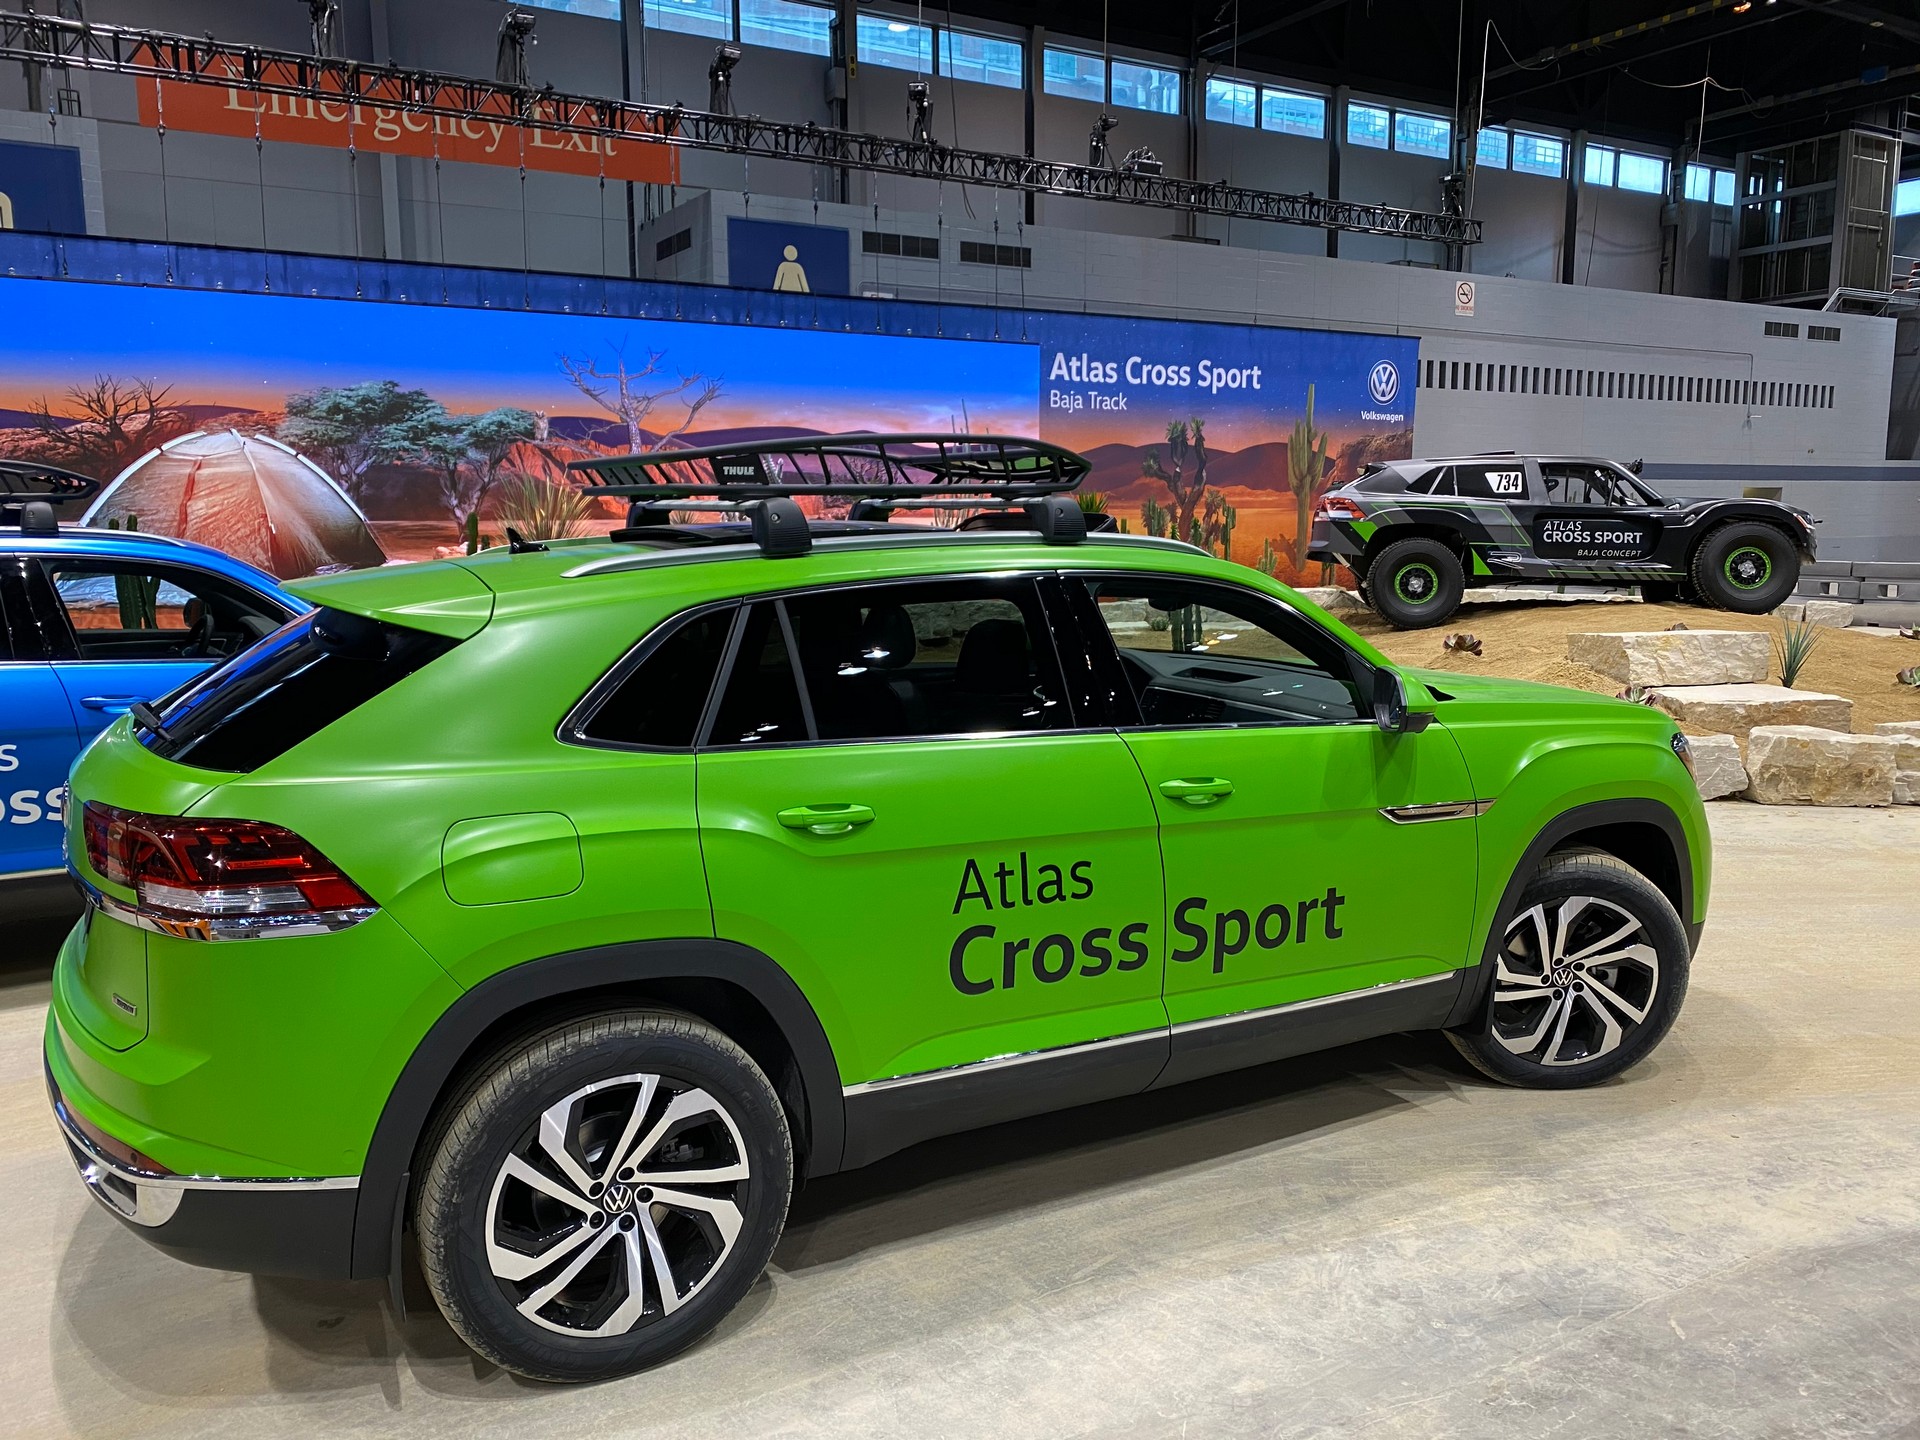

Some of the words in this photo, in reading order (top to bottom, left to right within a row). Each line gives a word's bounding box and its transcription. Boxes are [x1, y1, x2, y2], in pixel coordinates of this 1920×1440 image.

[1049, 352, 1118, 383] Atlas
[1125, 356, 1191, 386] Cross
[1197, 359, 1261, 394] Sport
[1050, 389, 1083, 413] Baja
[1088, 391, 1127, 410] Track
[1361, 411, 1404, 423] Volkswagen
[723, 466, 754, 475] THULE
[1496, 474, 1519, 491] 734
[1543, 521, 1582, 531] ATLAS
[1543, 531, 1591, 543] CROSS
[1594, 532, 1643, 544] SPORT
[952, 851, 1094, 915] Atlas
[949, 922, 1149, 996] Cross
[1170, 887, 1346, 974] Sport
